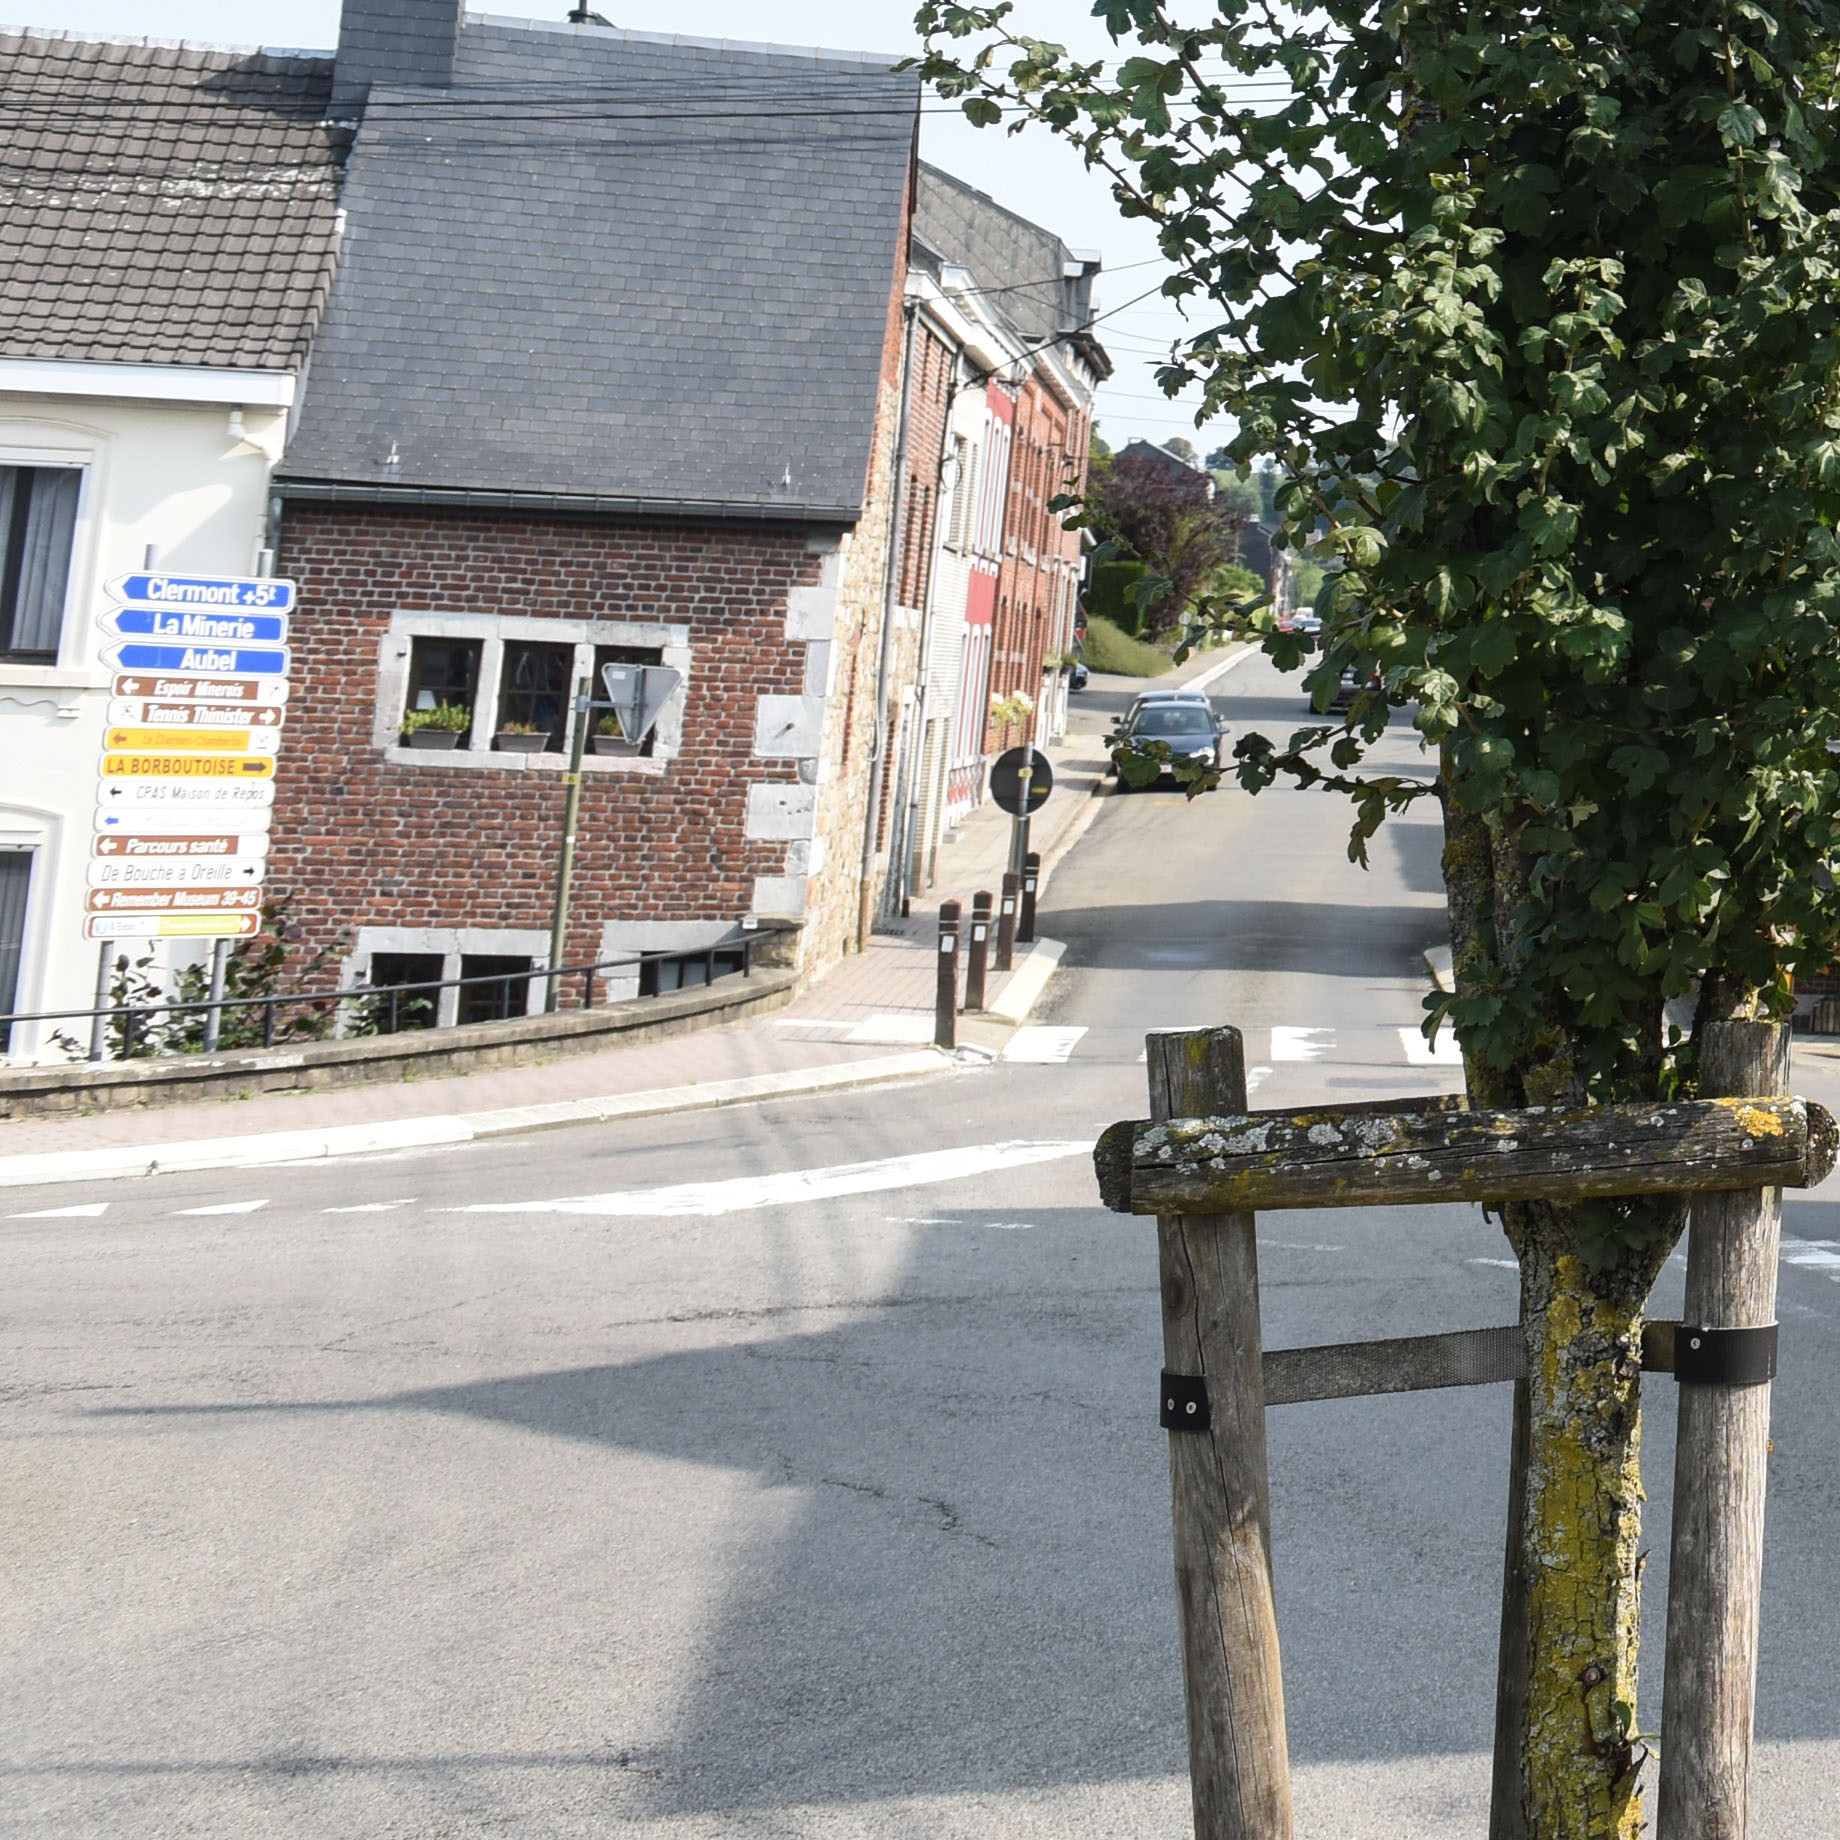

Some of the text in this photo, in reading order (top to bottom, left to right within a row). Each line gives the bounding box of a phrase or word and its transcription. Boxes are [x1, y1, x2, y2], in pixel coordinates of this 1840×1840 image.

[147, 578, 240, 604] Clermont
[153, 613, 255, 638] La Minerie
[180, 648, 237, 671] Aubel
[154, 680, 193, 698] Espoir
[147, 705, 255, 724] Tennis Thimister
[108, 758, 236, 774] LA BORBOUTOISE
[136, 786, 265, 803] CPAS Maison de Repos
[125, 838, 228, 854] Parcours santé
[101, 865, 119, 881] De
[124, 865, 174, 881] Bouche
[191, 864, 232, 880] Oreille
[111, 891, 173, 907] Remember
[173, 891, 220, 906] Museum
